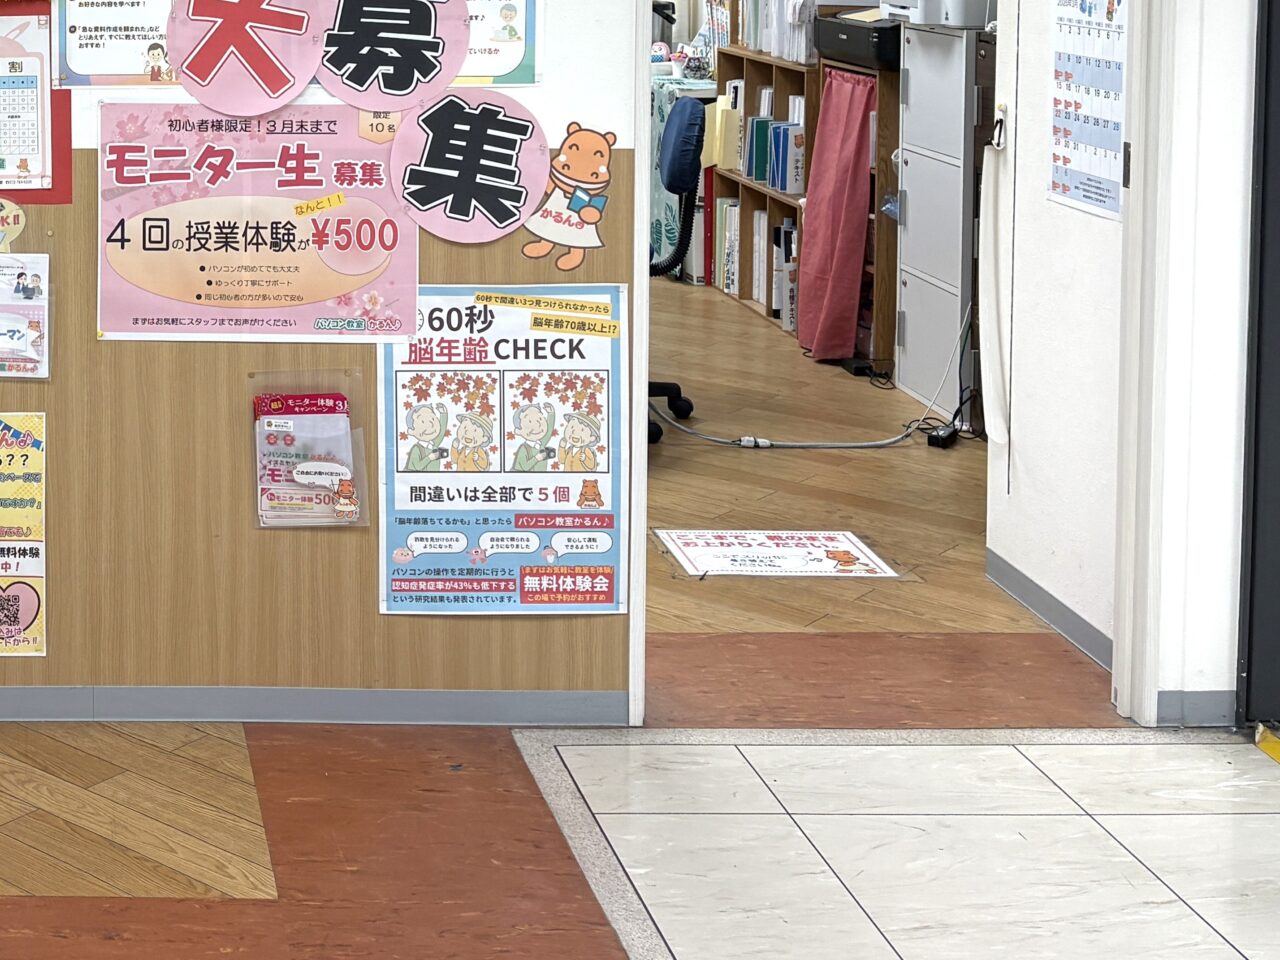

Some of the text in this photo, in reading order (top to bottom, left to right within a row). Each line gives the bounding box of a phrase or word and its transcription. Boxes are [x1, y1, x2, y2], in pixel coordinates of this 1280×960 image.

[105, 142, 384, 190] モニター生 募集
[215, 279, 292, 287] ゆっくり丁寧にサポート
[204, 293, 303, 302] 同じ初心者の方が多いので安心
[476, 294, 610, 313] 60秒で間違い3つ見つけられなかったら
[132, 318, 297, 326] まずはお気軽にスタッフまでお声がけください
[427, 305, 495, 334] 60秒
[408, 337, 586, 364] 脳年齢 CHECK
[392, 567, 515, 577] パソコンの操作を定期的に行うと
[392, 581, 515, 590] 認知症発症率が43%も低下する
[524, 575, 609, 592] 無料体験会
[392, 595, 517, 603] という研究結果も発表されています。
